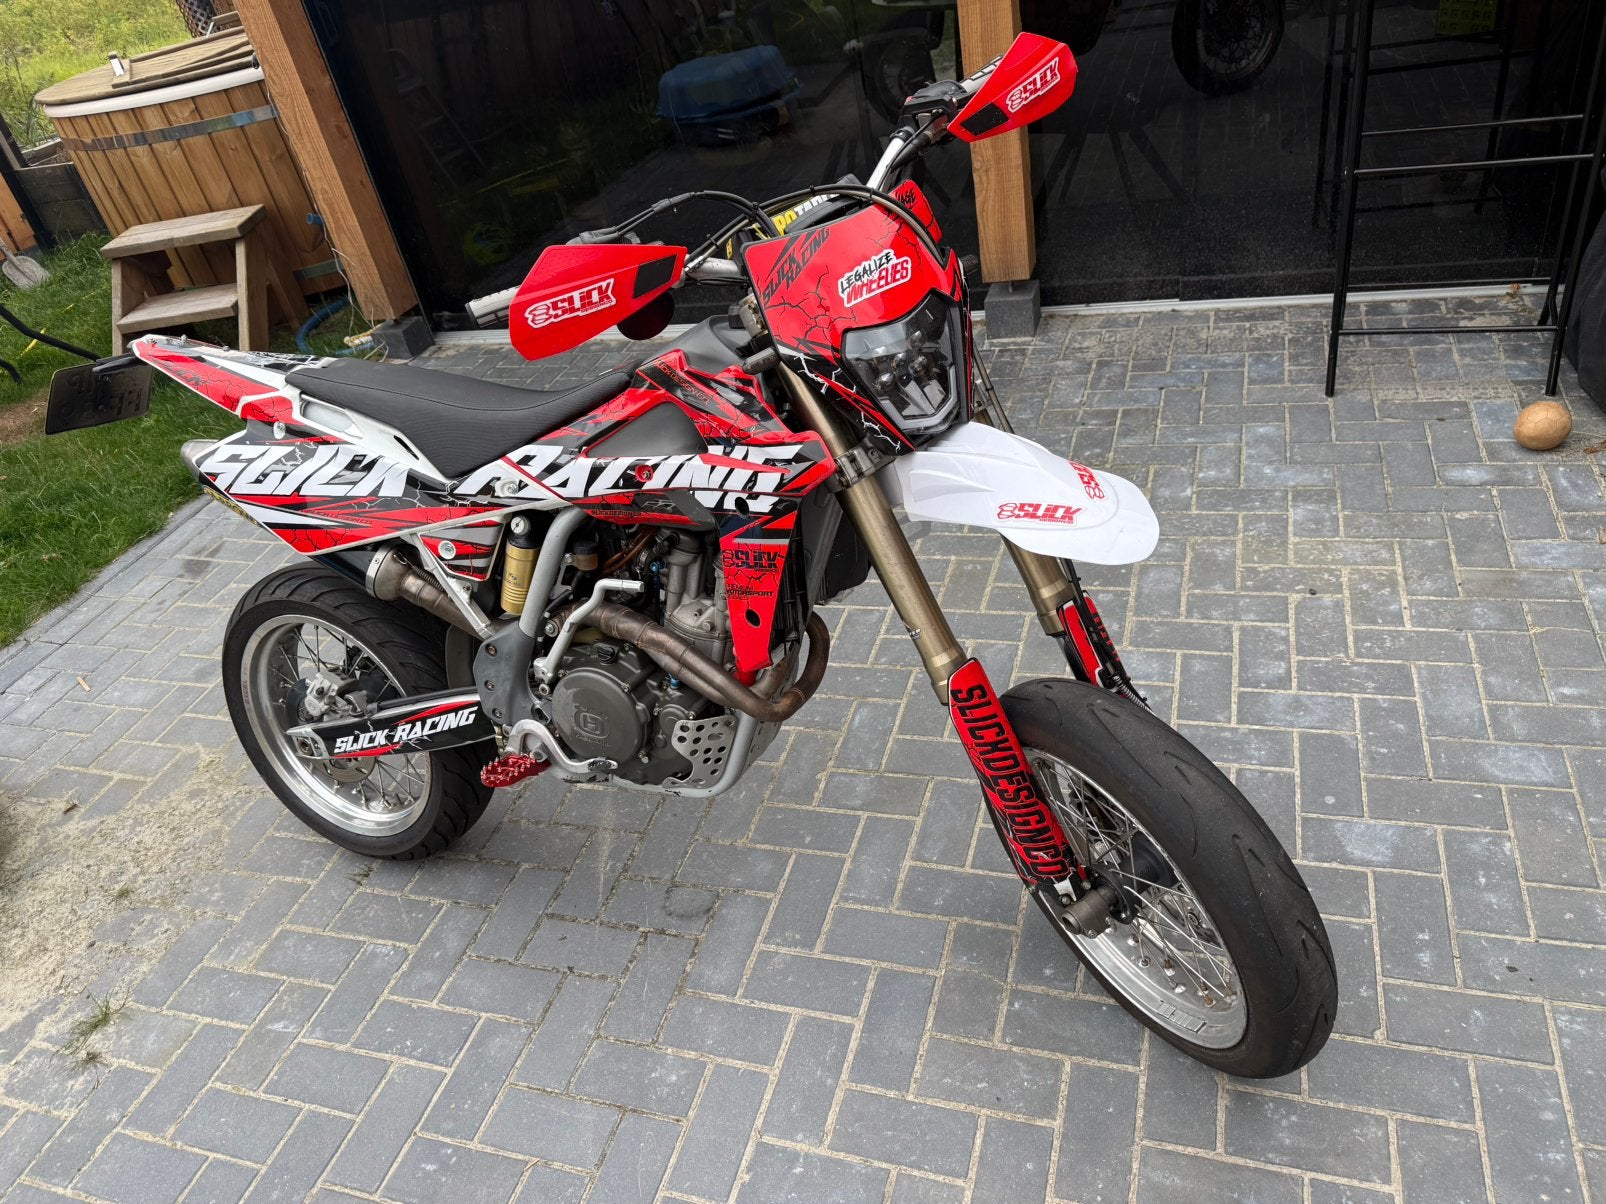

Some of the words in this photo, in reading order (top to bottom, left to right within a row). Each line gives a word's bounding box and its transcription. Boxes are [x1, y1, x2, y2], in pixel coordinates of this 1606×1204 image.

[1022, 60, 1058, 101] SLICK
[840, 251, 894, 294] LEGALIZE
[846, 259, 910, 304] WHEELIES
[551, 282, 612, 318] SLICK
[198, 444, 410, 497] SLICK
[453, 443, 805, 514] RACING
[1015, 502, 1083, 522] SLICK
[734, 550, 778, 569] SLICK
[333, 727, 390, 755] SLICK
[394, 706, 479, 743] RACING
